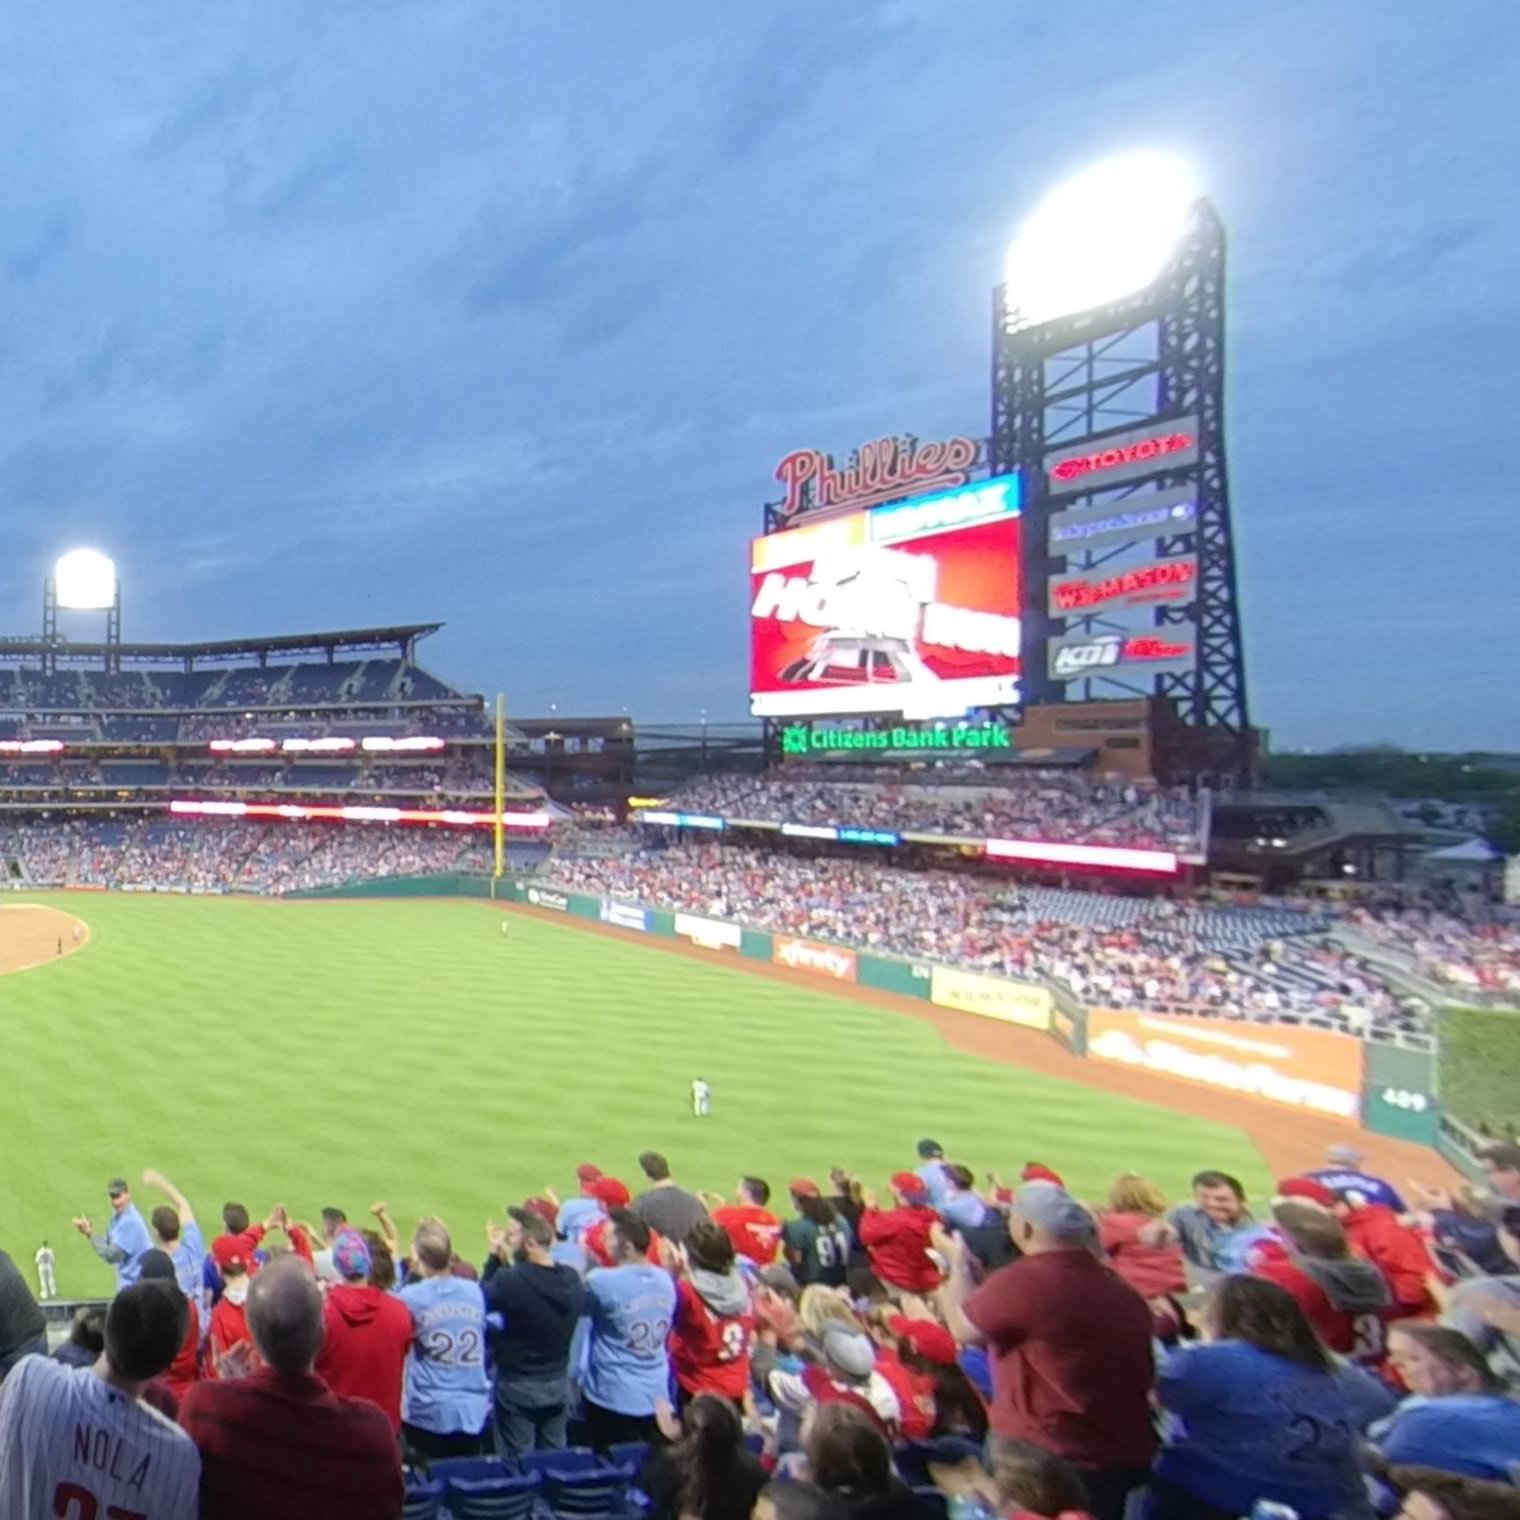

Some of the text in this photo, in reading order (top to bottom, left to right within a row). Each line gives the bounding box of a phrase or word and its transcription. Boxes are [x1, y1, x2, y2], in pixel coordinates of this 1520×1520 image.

[1088, 433, 1192, 469] TOYOTA
[774, 436, 976, 516] Phillies
[811, 725, 1010, 749] Citizens Bank Park
[430, 1326, 482, 1367] 22
[74, 1422, 151, 1494] NOLA
